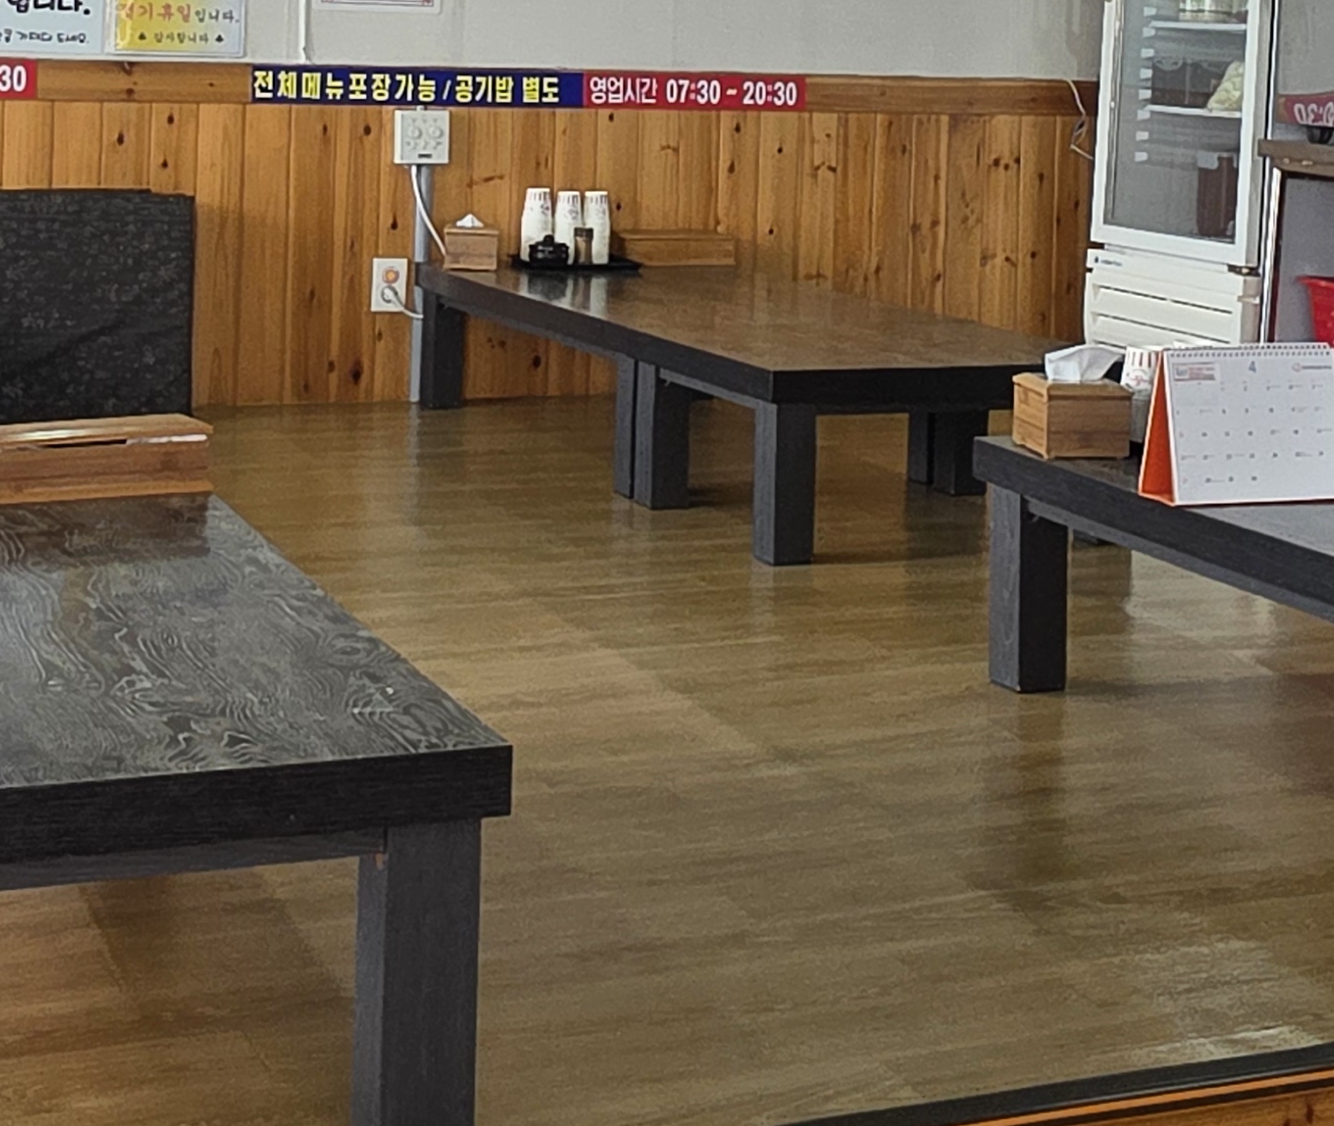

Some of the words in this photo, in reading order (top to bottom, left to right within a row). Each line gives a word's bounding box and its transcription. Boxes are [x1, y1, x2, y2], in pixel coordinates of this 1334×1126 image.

[522, 74, 560, 104] 별도
[589, 76, 658, 105] 영업시간
[666, 78, 721, 105] 07:30
[742, 79, 798, 106] 20:30
